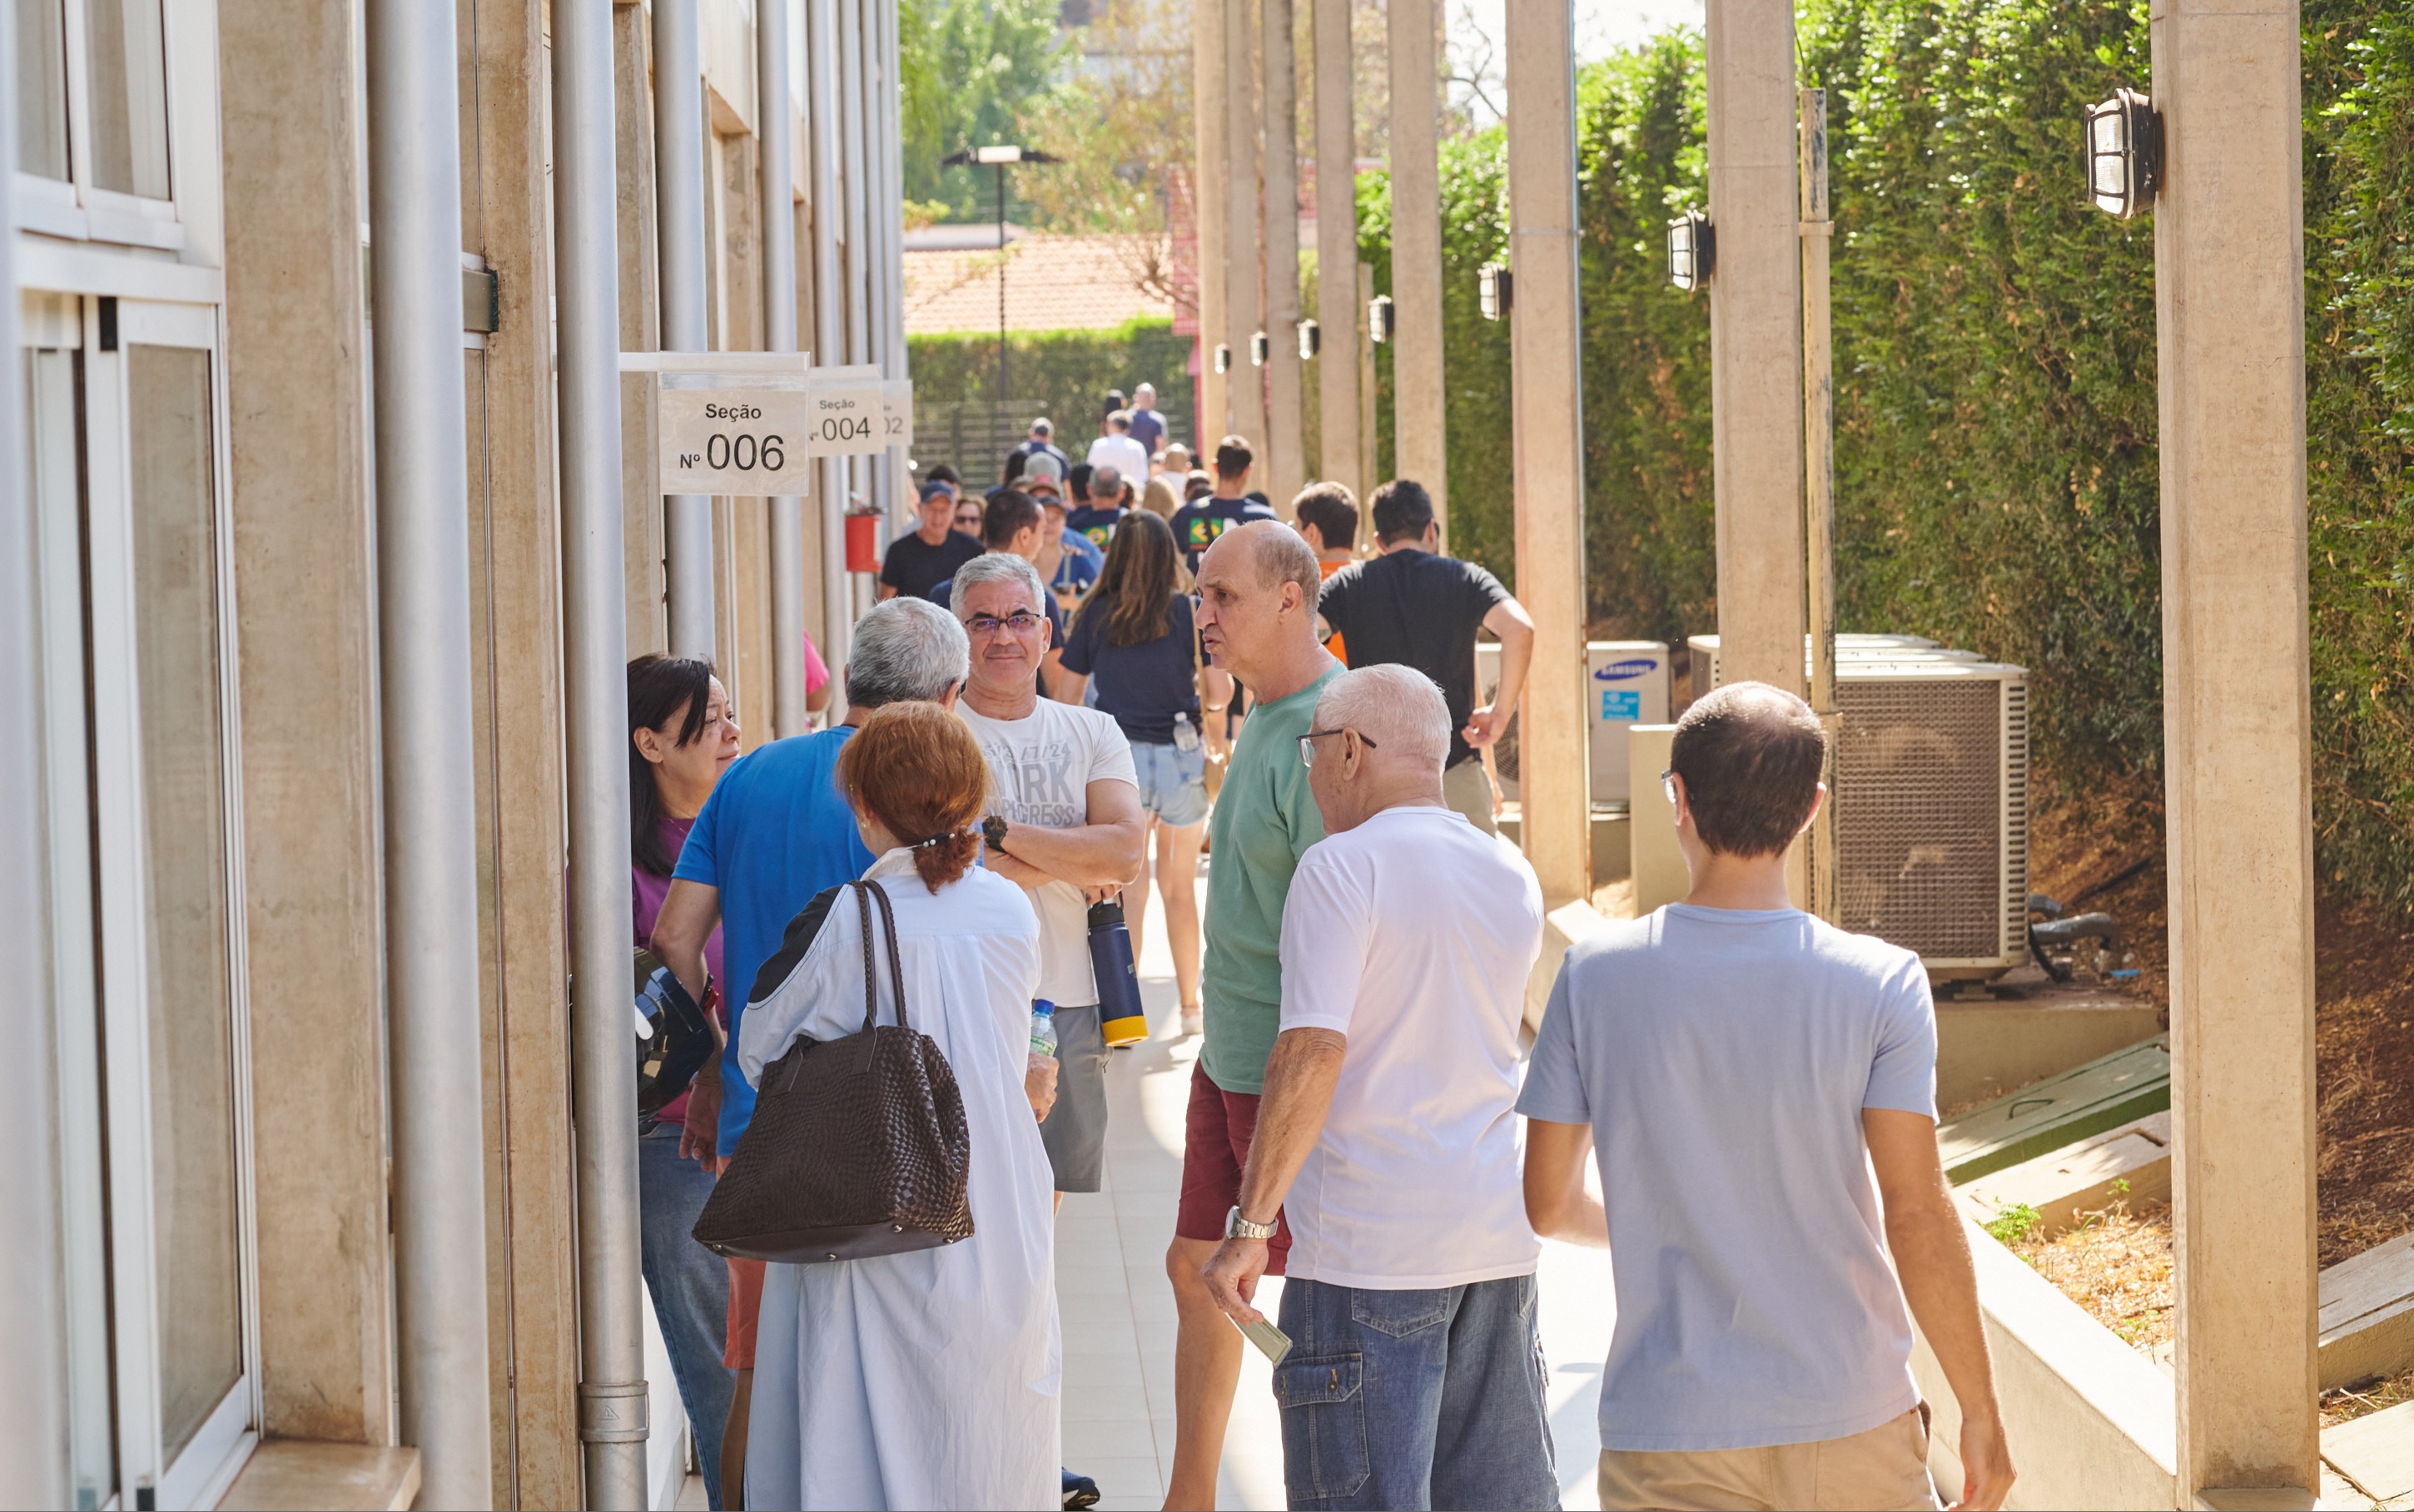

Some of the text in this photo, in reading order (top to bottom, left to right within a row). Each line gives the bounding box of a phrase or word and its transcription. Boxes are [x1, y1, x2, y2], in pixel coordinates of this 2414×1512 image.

[705, 404, 762, 423] Seção
[819, 399, 856, 411] Seção
[822, 417, 872, 441] 004
[680, 434, 785, 472] Nº 006
